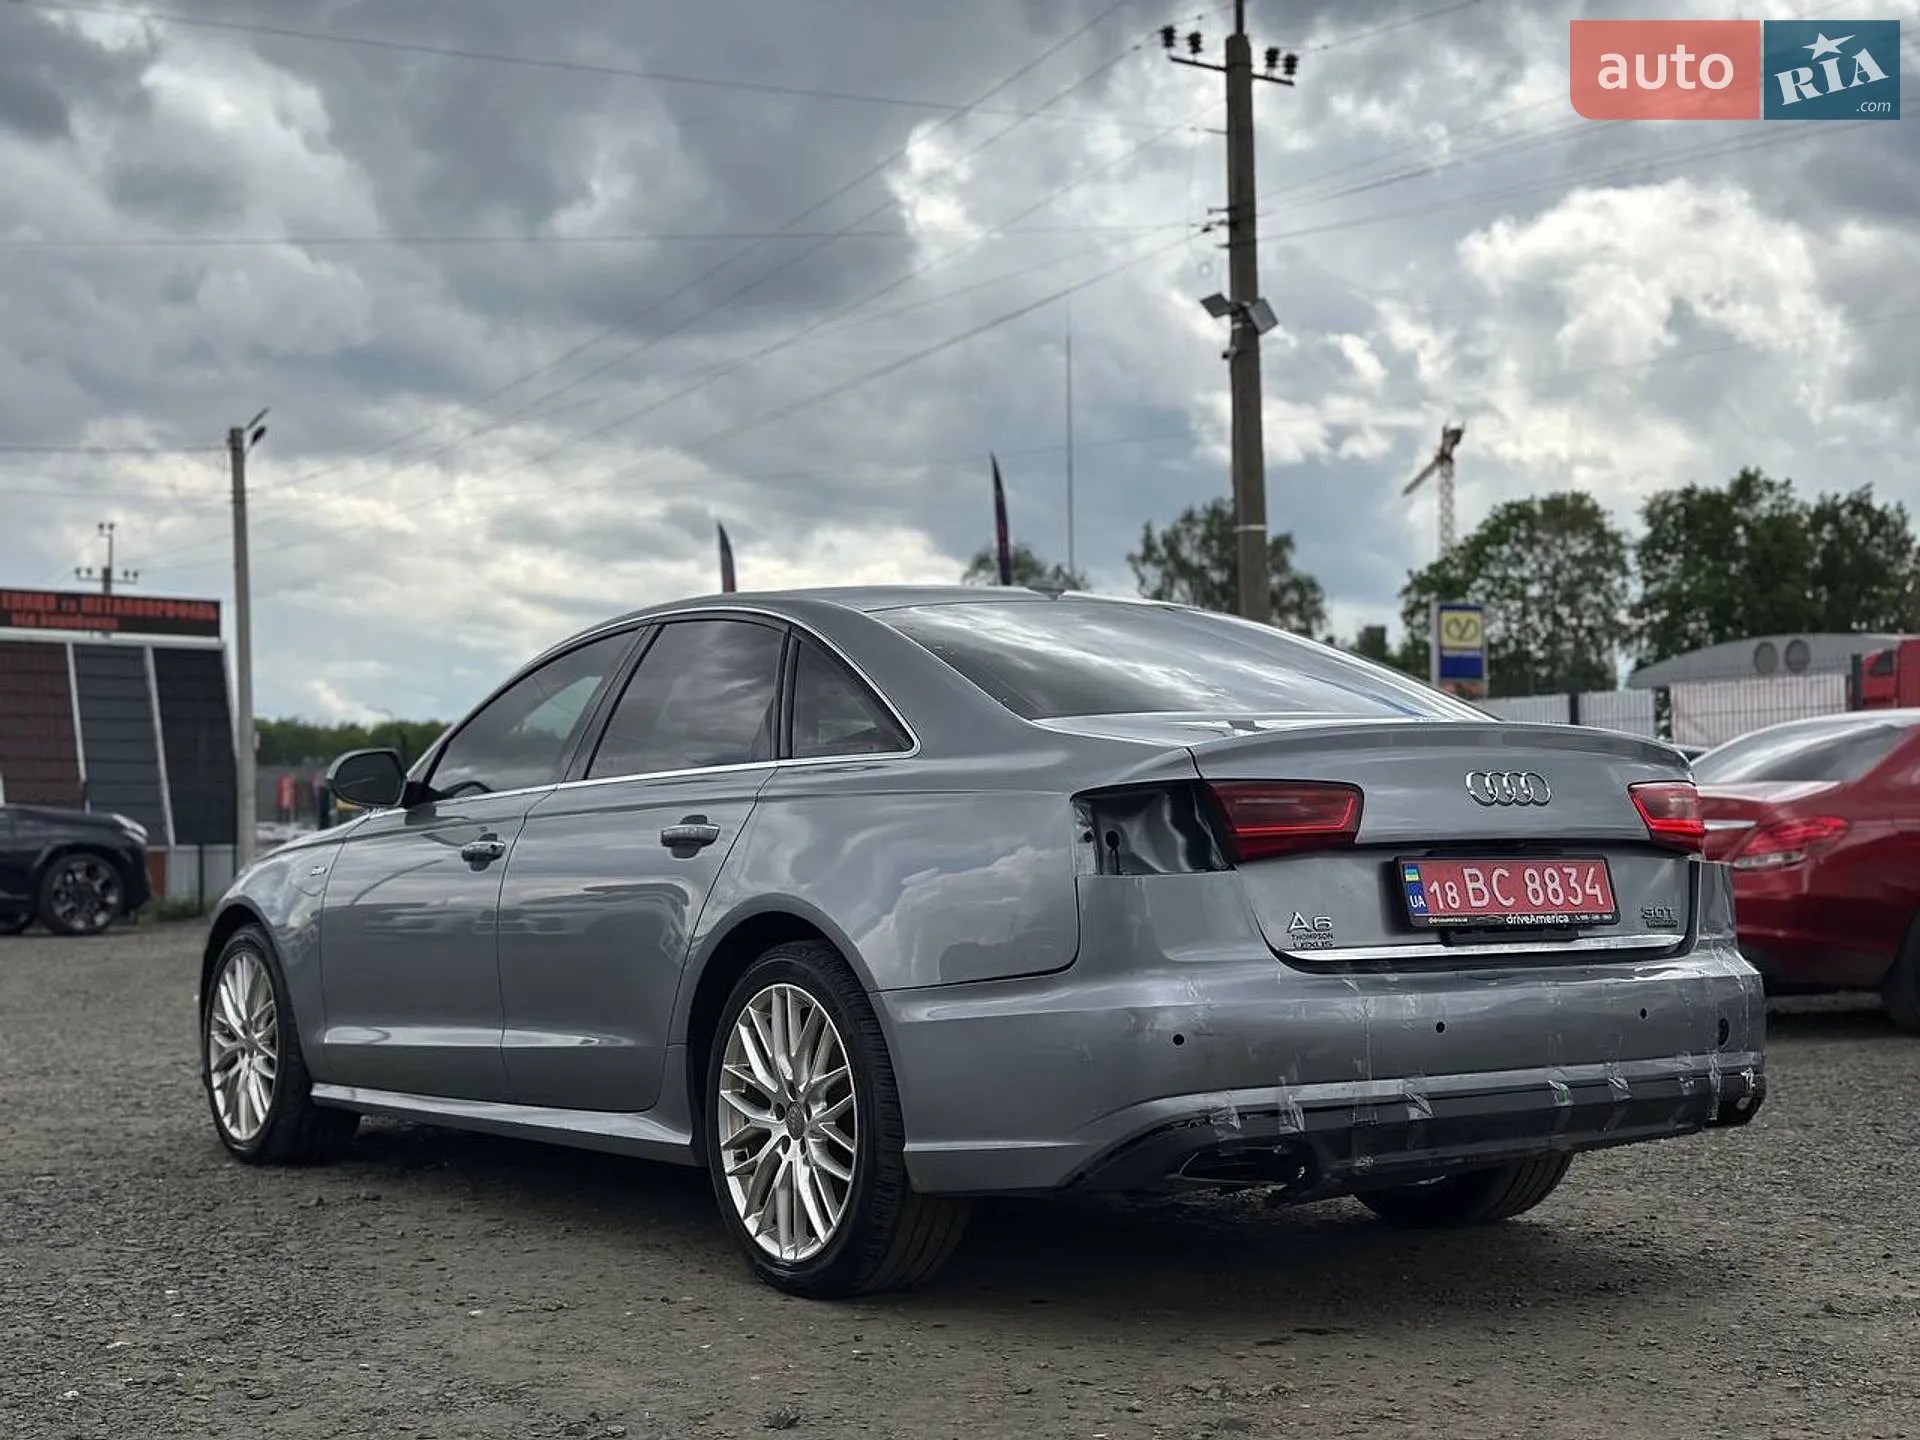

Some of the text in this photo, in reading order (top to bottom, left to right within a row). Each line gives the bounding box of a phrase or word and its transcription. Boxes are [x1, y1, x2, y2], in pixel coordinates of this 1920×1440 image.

[1429, 867, 1604, 910] 18 BC 8834
[1410, 895, 1426, 909] UA
[1287, 911, 1333, 933] A6
[1506, 912, 1569, 925] driveAmerica
